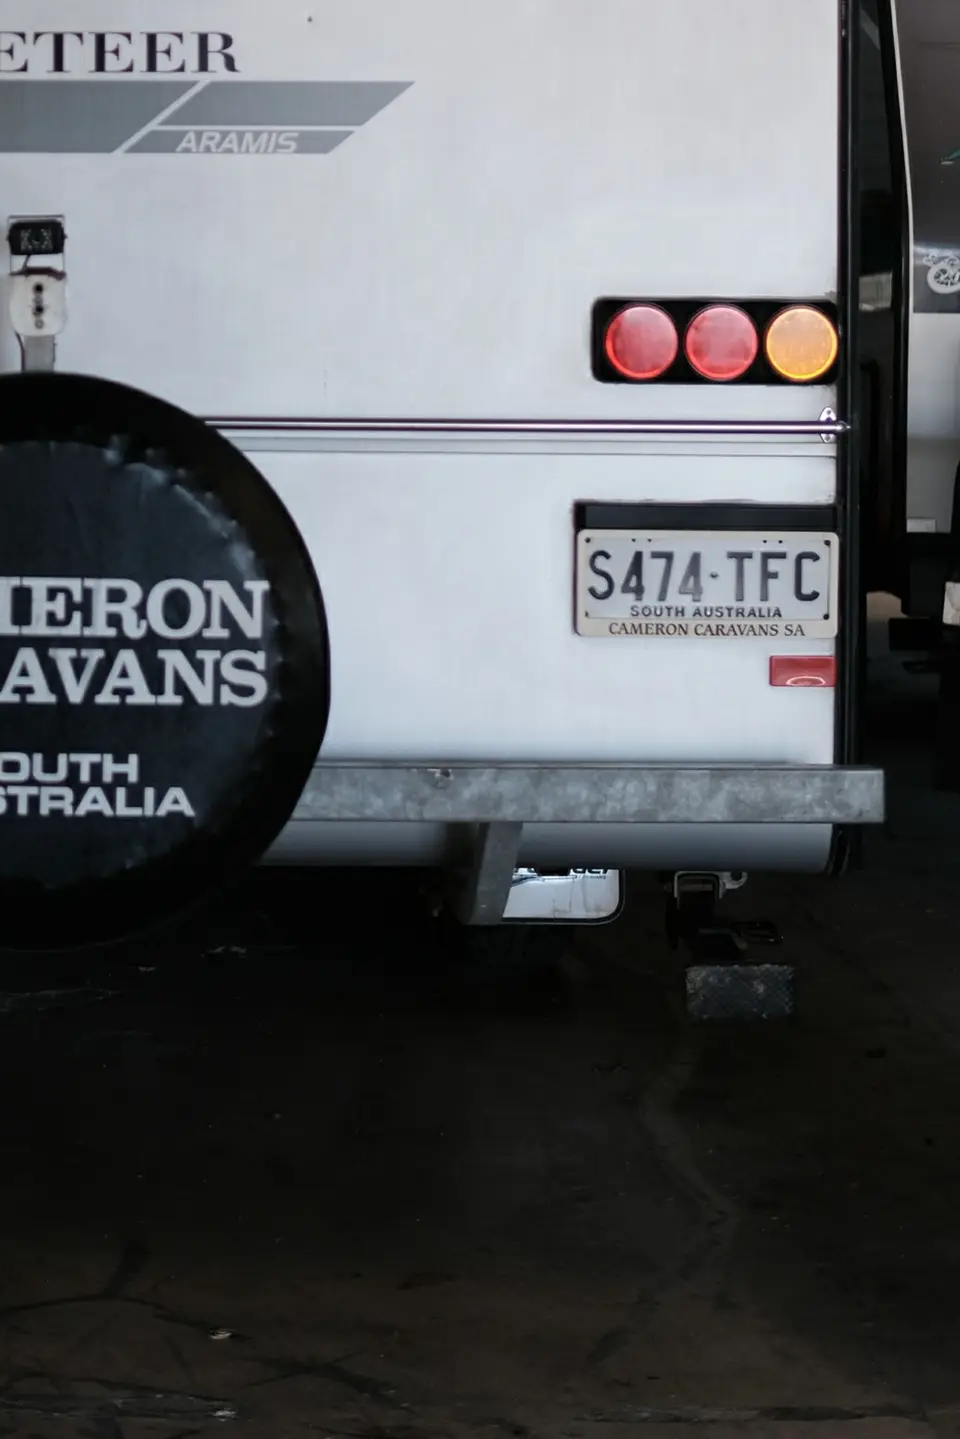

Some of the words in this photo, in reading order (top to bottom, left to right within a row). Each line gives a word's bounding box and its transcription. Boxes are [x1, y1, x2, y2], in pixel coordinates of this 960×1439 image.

[175, 130, 299, 153] ARAMIS
[630, 605, 686, 618] SOUTH
[692, 606, 783, 619] AUSTRALIA
[608, 622, 689, 636] CAMERON
[694, 623, 779, 637] CARAVANS
[784, 624, 806, 637] SA
